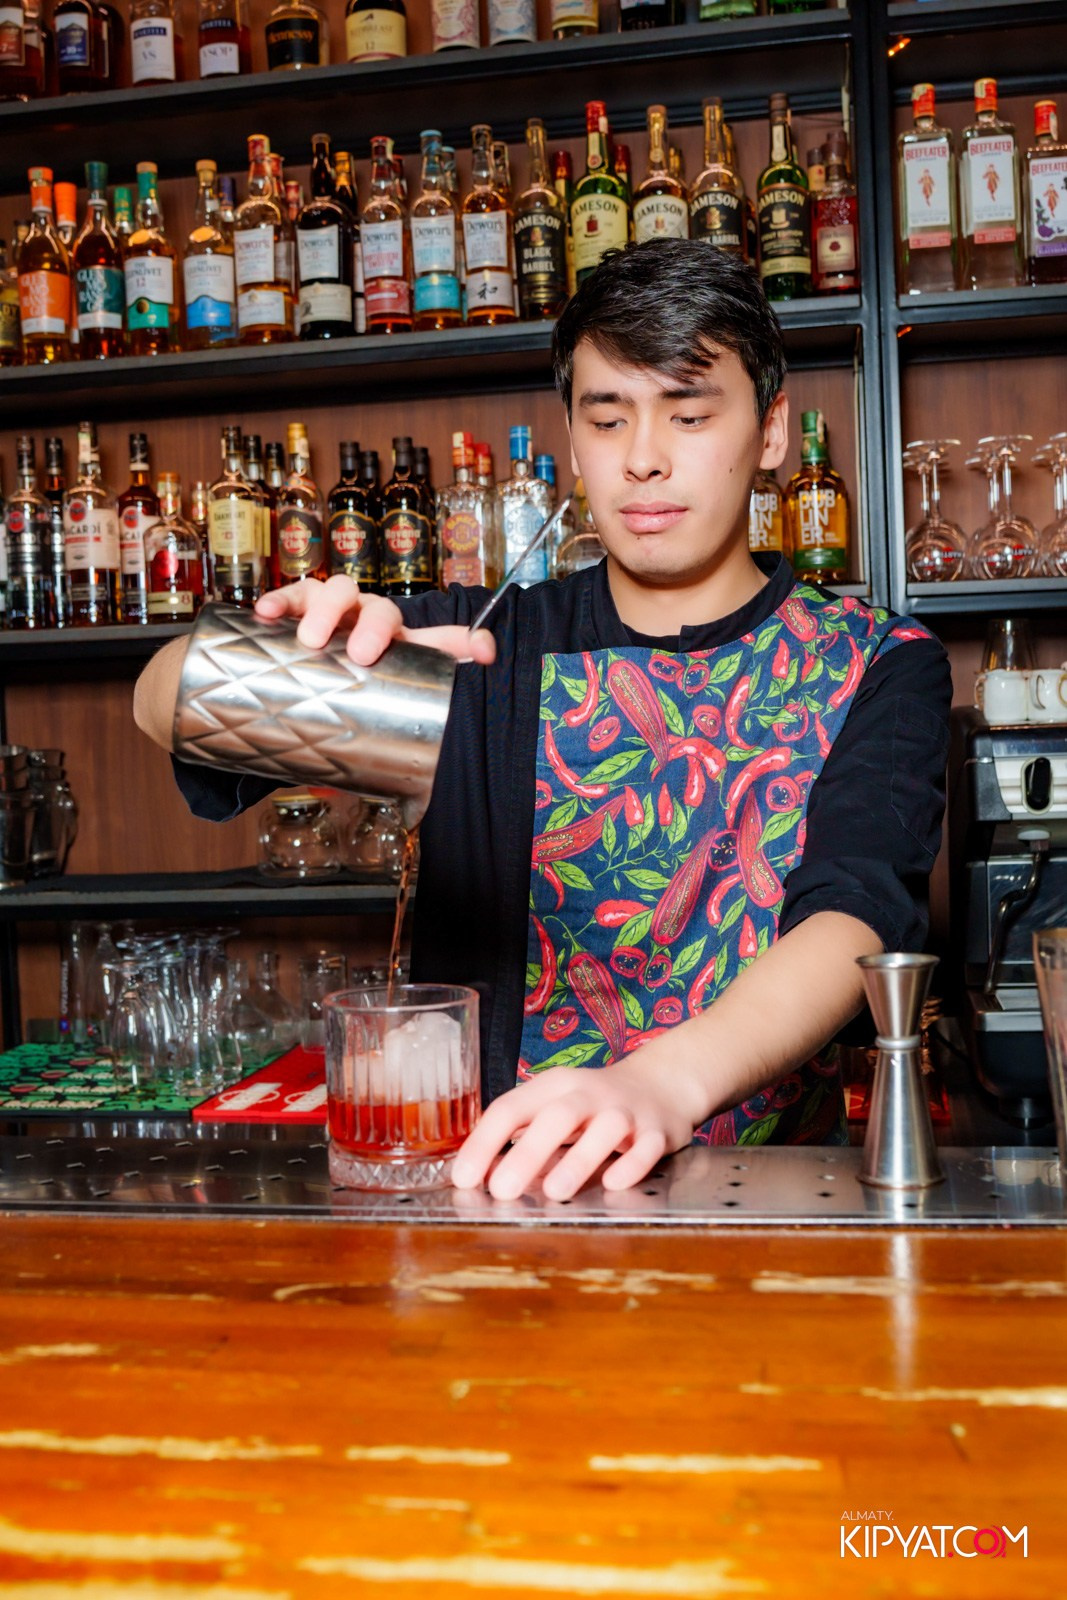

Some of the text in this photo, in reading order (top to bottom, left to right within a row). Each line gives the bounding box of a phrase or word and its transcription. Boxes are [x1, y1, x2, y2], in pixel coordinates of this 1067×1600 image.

[269, 31, 313, 42] Hennessy
[905, 146, 948, 161] BEEFEATER
[970, 141, 1012, 156] BEEFEATER
[690, 192, 738, 216] JAMESON
[758, 189, 805, 213] JAMESON
[572, 199, 619, 219] JAMESON
[636, 203, 684, 222] JAMESON
[514, 213, 561, 235] JAMESON
[523, 247, 552, 259] BLACK
[522, 261, 556, 274] BARREL
[750, 493, 778, 513] UB
[798, 488, 835, 509] DUB
[750, 511, 772, 530] IN
[800, 508, 829, 527] LIN
[280, 528, 311, 541] Havana
[331, 529, 366, 541] Havana
[384, 528, 420, 540] Havana
[801, 526, 824, 545] ER
[285, 538, 307, 552] Club
[337, 539, 359, 551] Club
[391, 538, 413, 550] Club
[344, 562, 353, 575] 7
[398, 561, 407, 574] 7
